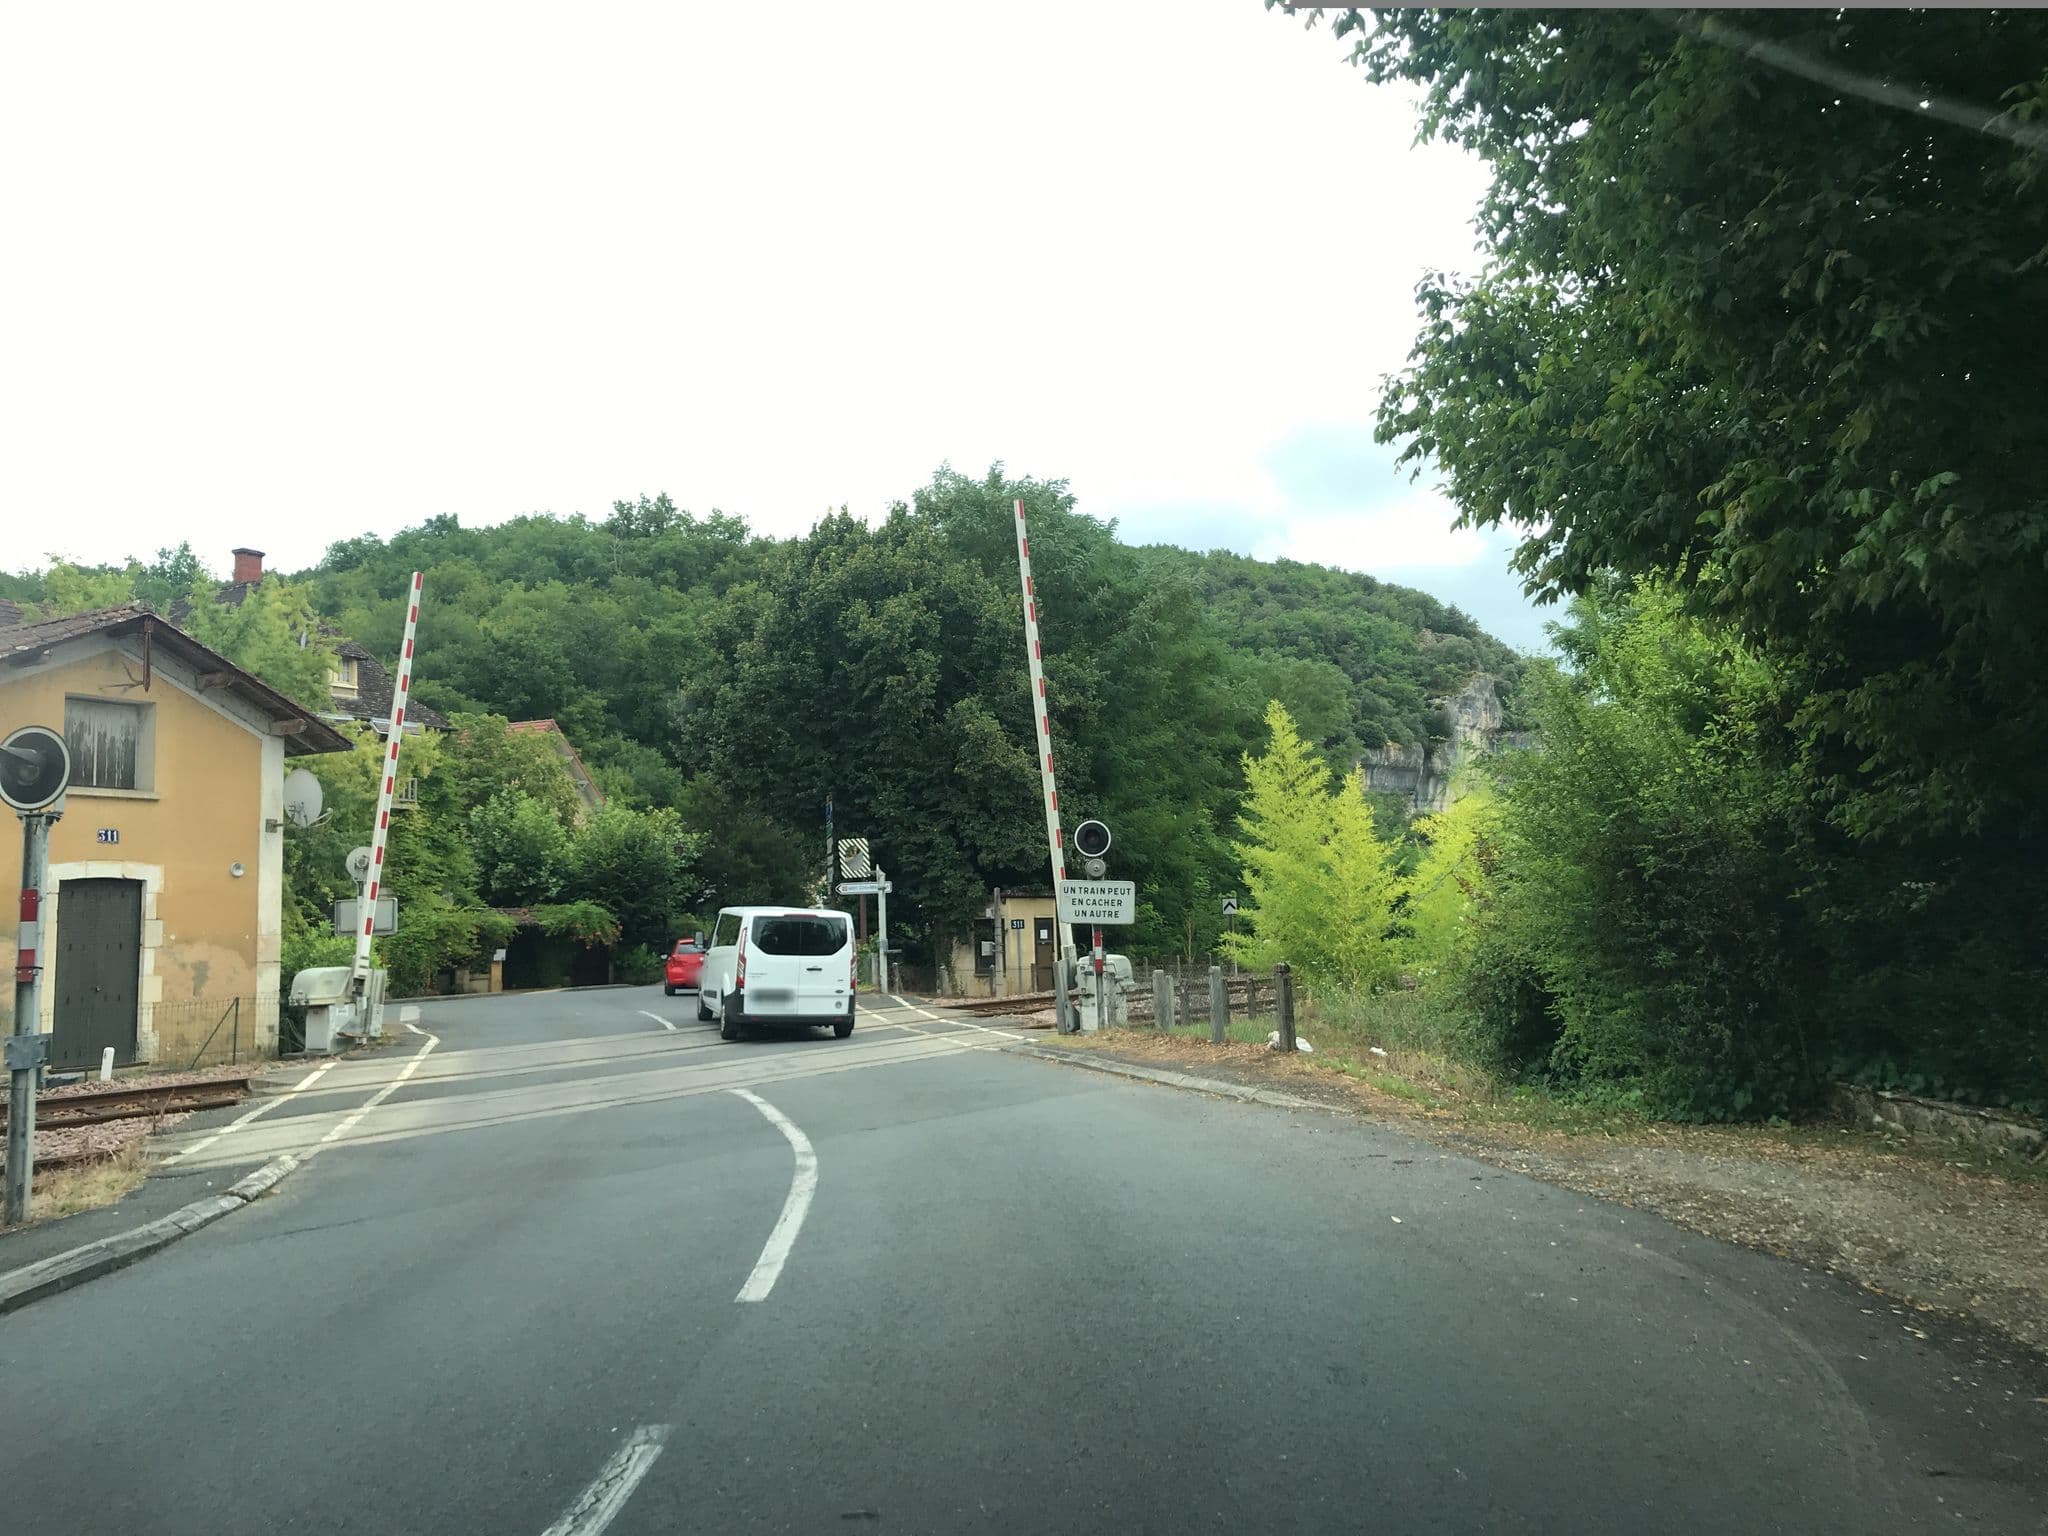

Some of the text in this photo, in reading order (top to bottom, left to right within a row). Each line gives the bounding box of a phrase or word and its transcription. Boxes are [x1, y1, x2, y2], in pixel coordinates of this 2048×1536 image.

[97, 829, 118, 842] 311
[1063, 886, 1132, 896] UN TRAIN PEUT
[1071, 898, 1123, 907] EN CACHER
[1074, 909, 1120, 918] UN AUTRE
